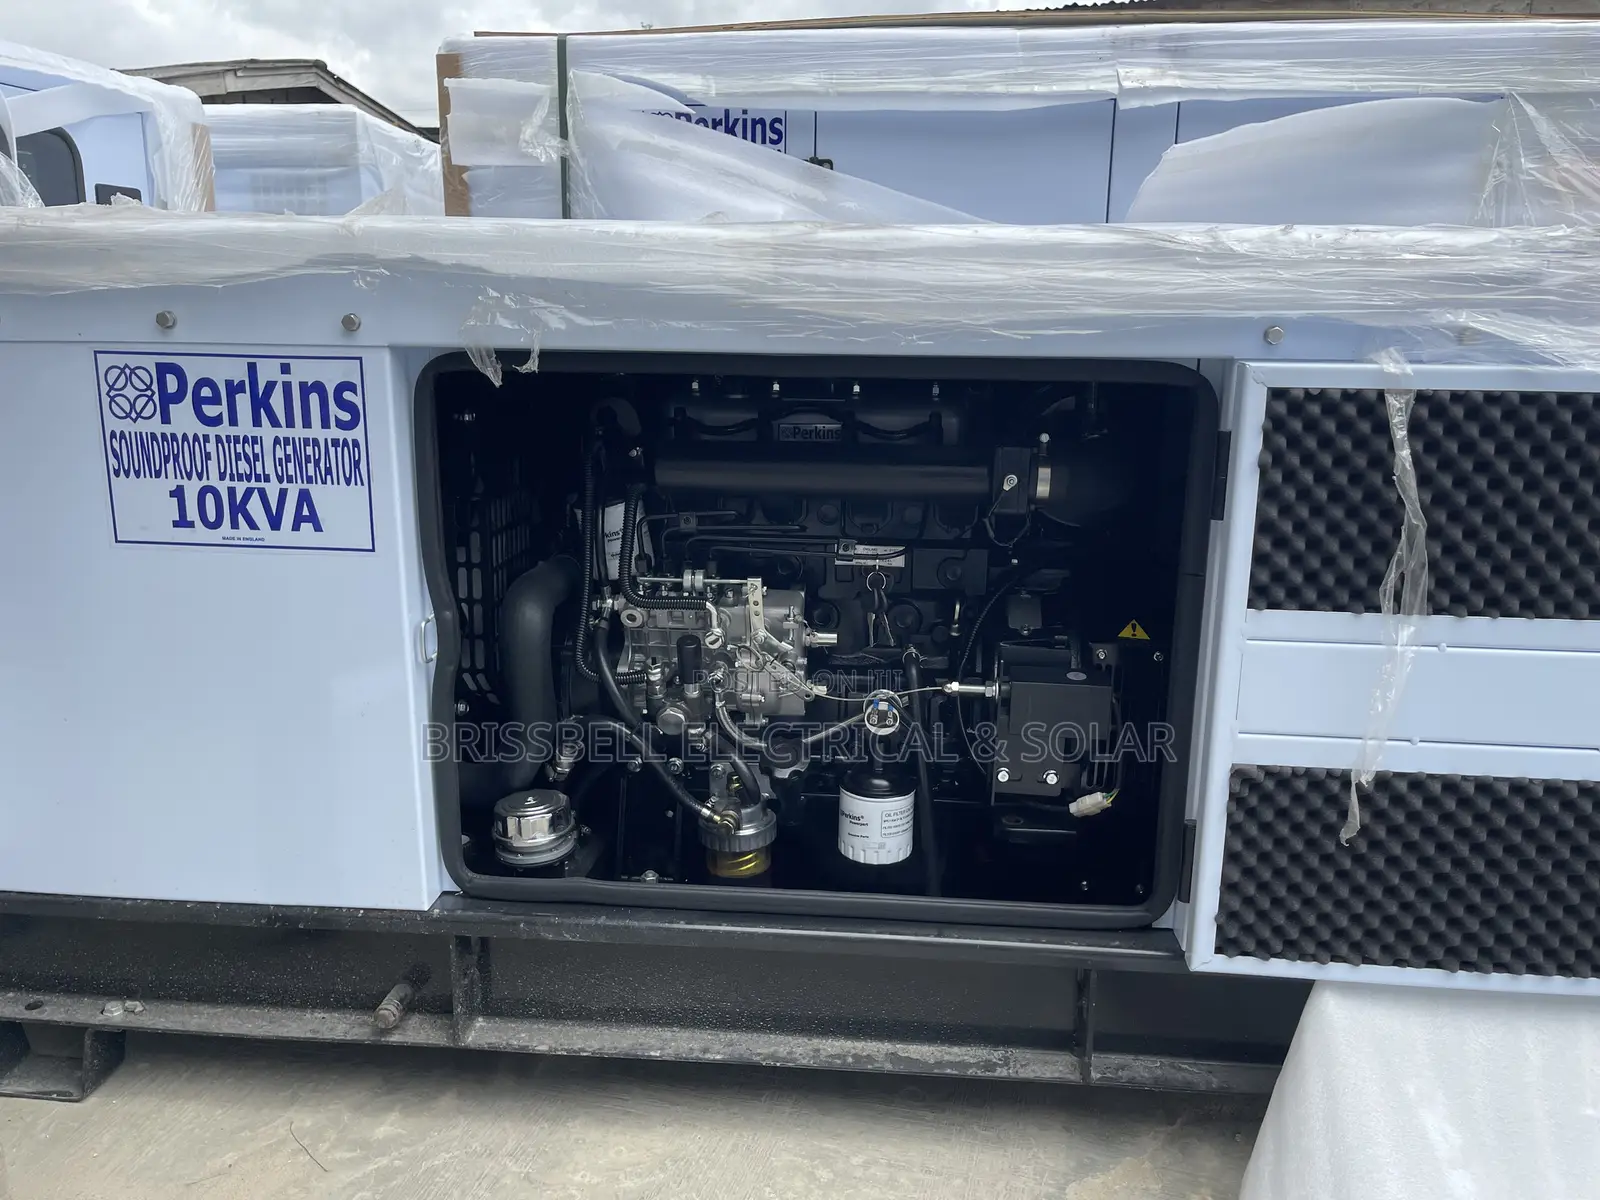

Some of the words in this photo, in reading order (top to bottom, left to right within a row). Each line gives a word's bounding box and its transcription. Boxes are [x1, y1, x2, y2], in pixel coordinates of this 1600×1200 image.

[155, 361, 361, 431] Perkins
[109, 429, 212, 482] SOUNDPROOF
[215, 433, 271, 484] DIESEL
[272, 435, 364, 487] GENERATOR
[793, 425, 841, 440] Perkins
[169, 484, 324, 533] 10KVA
